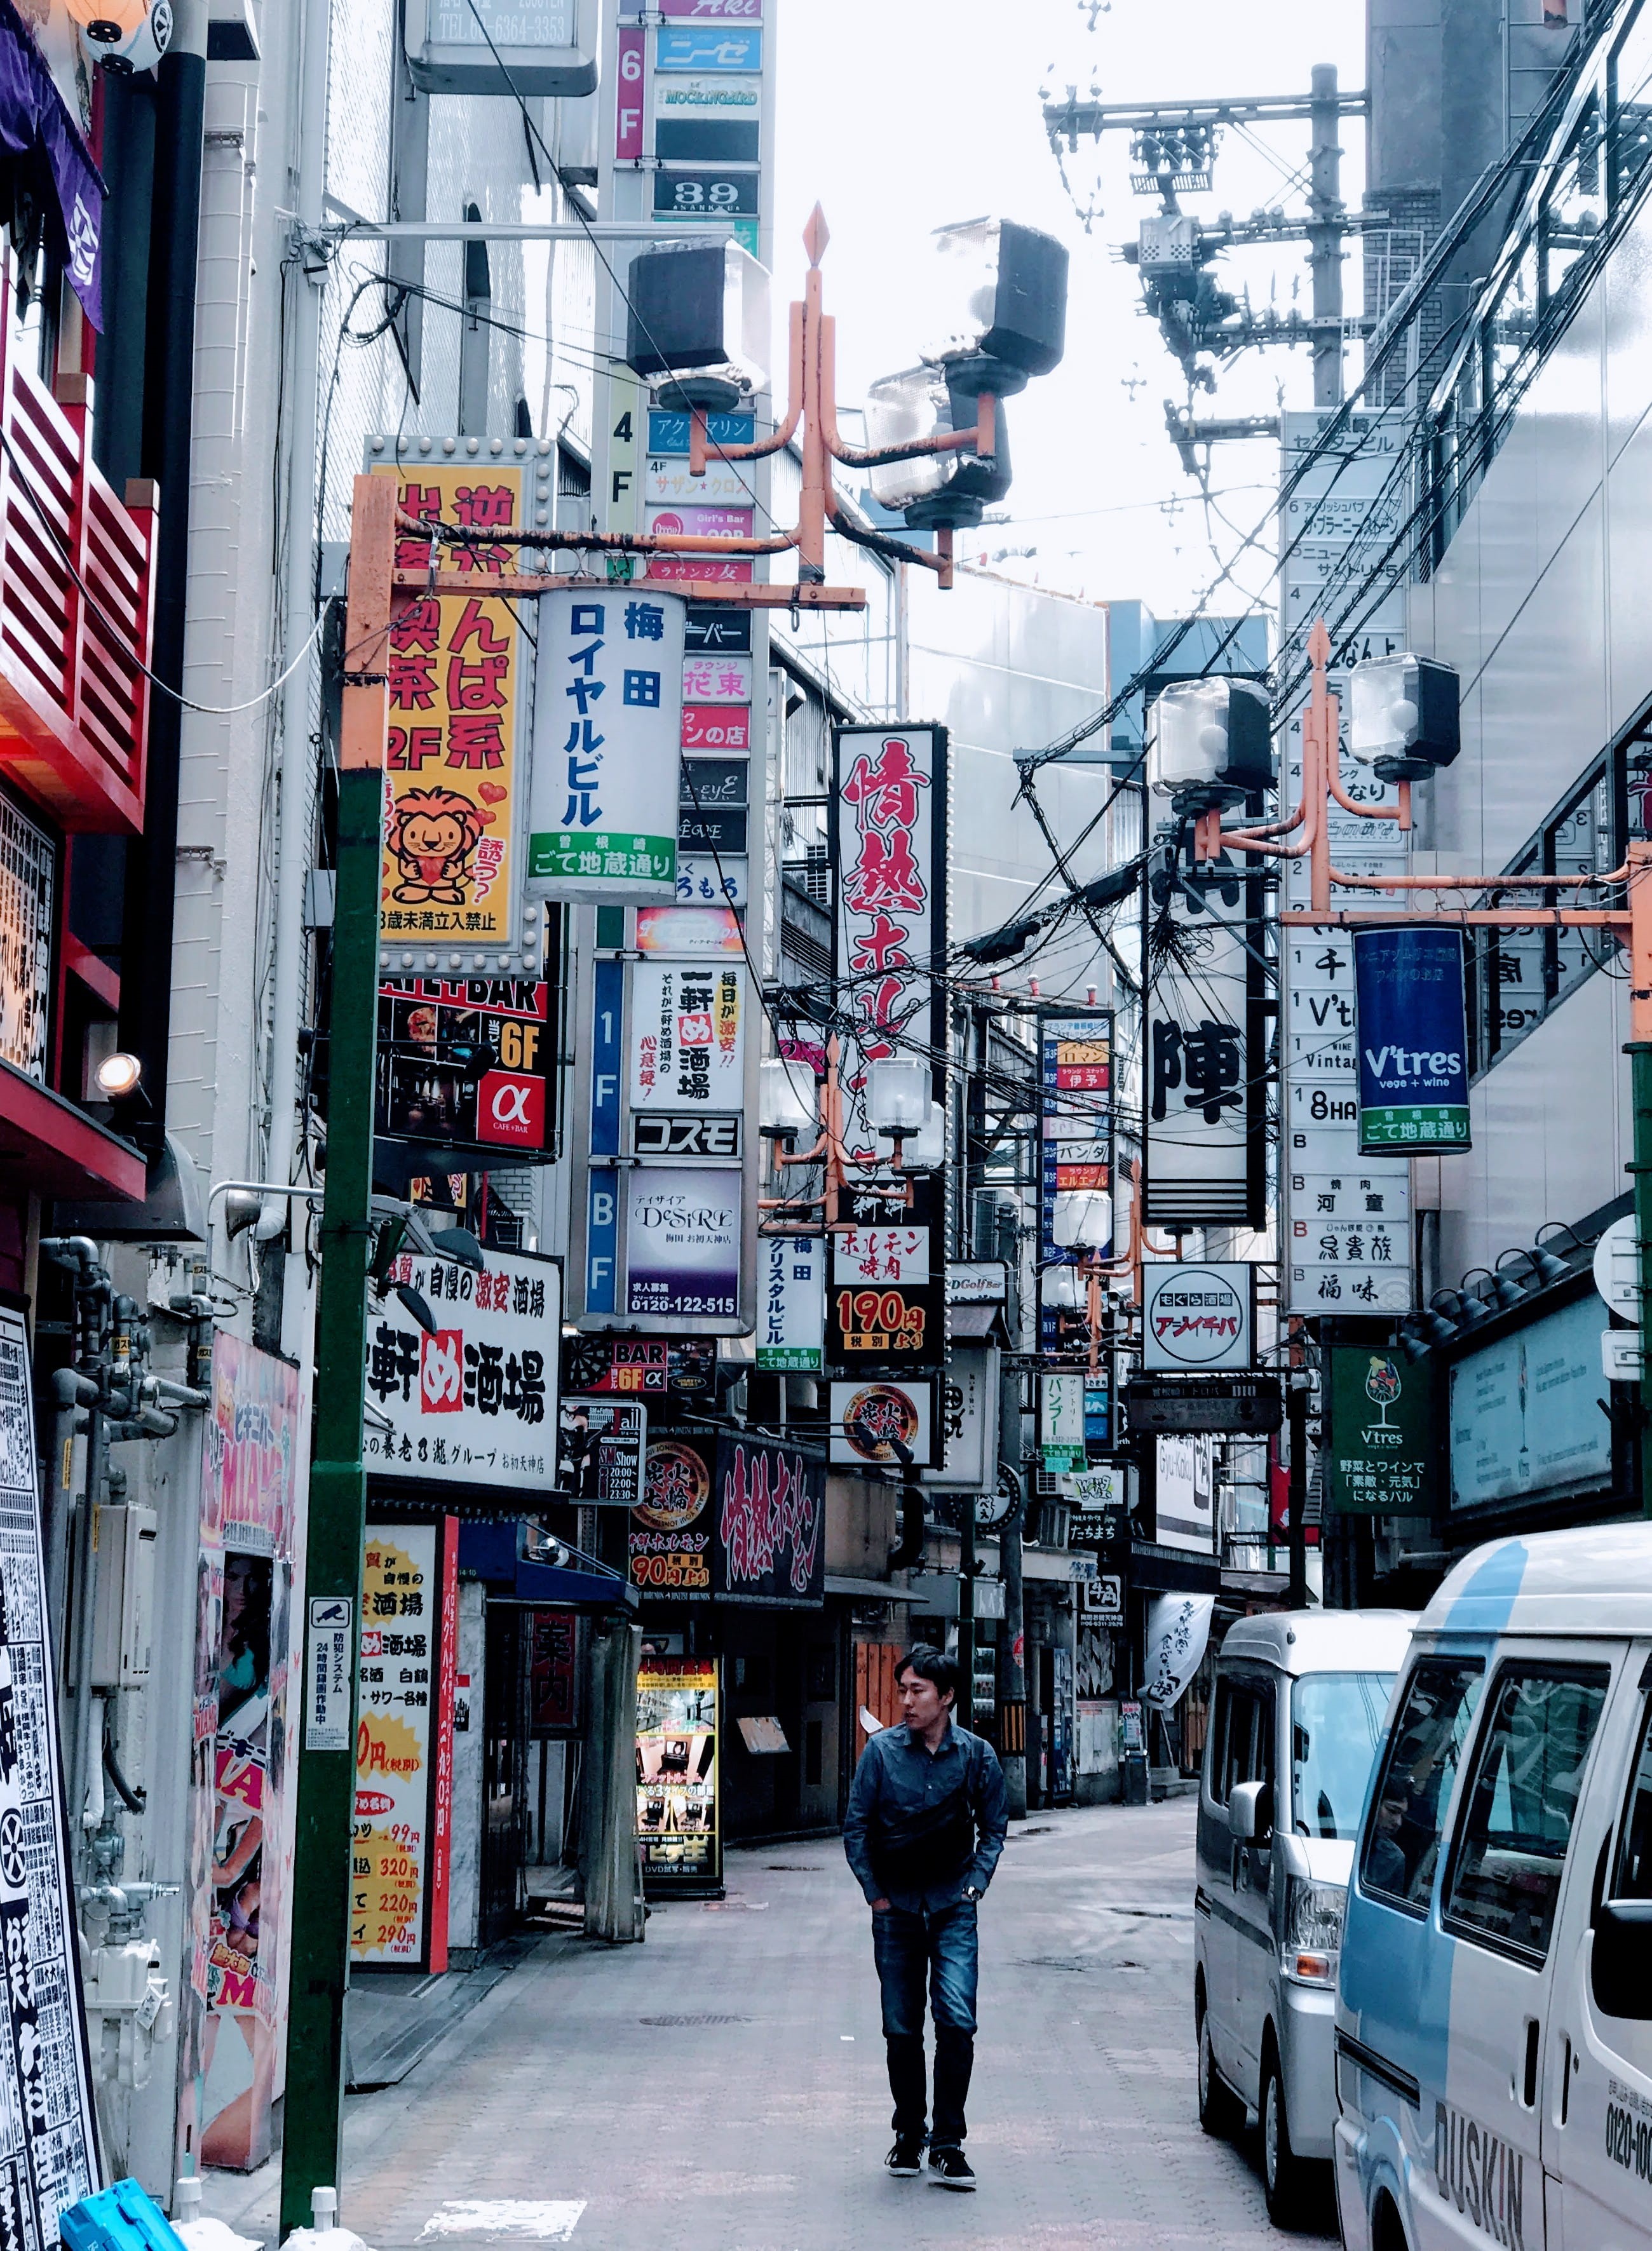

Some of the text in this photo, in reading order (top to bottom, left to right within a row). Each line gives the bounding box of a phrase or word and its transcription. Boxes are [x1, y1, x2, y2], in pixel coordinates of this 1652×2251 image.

[439, 13, 467, 39] TEL
[665, 89, 757, 105] MOCKINGBIRD
[675, 182, 738, 204] 39
[658, 419, 747, 437] アクマリン
[1294, 435, 1394, 452] セタービル
[650, 461, 667, 473] 4F
[1290, 501, 1299, 513] 6
[697, 515, 745, 524] Girl's Bar
[1291, 588, 1300, 599] 4
[623, 602, 664, 708] 梅田
[684, 672, 745, 696] 花束
[560, 604, 606, 827] ロイヤルビル
[682, 726, 746, 745] ンの店
[1291, 722, 1301, 733] 4
[388, 726, 442, 771] 2F
[1291, 765, 1301, 776] 4
[535, 849, 670, 877] ごて地蔵通り
[1293, 862, 1302, 875] 2
[1295, 950, 1301, 963] 1
[1294, 992, 1355, 1026] 1 V't
[677, 971, 714, 1099] 一軒め酒場
[501, 1022, 539, 1069] 6F
[1065, 1052, 1102, 1062] ロマン
[1365, 1044, 1461, 1078] V'tres
[1070, 1074, 1097, 1087] 伊予
[1379, 1079, 1407, 1088] vege
[1423, 1077, 1450, 1087] wine
[637, 1118, 736, 1153] コスモ
[1366, 1121, 1466, 1139] ごて地蔵通り
[1294, 1134, 1306, 1147] B
[1293, 1176, 1304, 1190] B
[1317, 1194, 1384, 1212] 河童
[1294, 1221, 1307, 1237] B
[840, 1231, 924, 1255] ホルモン
[1294, 1269, 1304, 1281] B
[632, 1283, 669, 1293] 求人募集
[768, 1238, 785, 1345] クリスタルビル
[632, 1297, 735, 1313] 0120-122-515
[1160, 1294, 1233, 1306] もぐら酒場
[836, 1290, 926, 1332] 190円
[616, 1344, 665, 1364] BAR
[758, 1356, 820, 1369] ごて地蔵通り
[366, 1321, 545, 1424] 軒め酒場
[618, 1367, 642, 1389] 6F
[1049, 1377, 1063, 1435] バンブー
[363, 1433, 497, 1468] の養老乃瀧グループ
[616, 1452, 637, 1466] Show
[1340, 1460, 1425, 1474] 野菜とワインで
[1353, 1490, 1412, 1502] になるバル
[1071, 1525, 1114, 1540] たちまち
[384, 1572, 424, 1585] 自慢の
[1090, 1582, 1117, 1604] 牛角
[333, 1633, 344, 1693] 防犯システム
[316, 1643, 328, 1724] 24時間録画作動中
[637, 1785, 714, 1797] べる3タイプの部屋
[381, 1858, 419, 1879] 320円
[379, 1893, 417, 1913] 220円
[377, 1924, 416, 1945] 290円
[1435, 2100, 1524, 2251] DUSKIN
